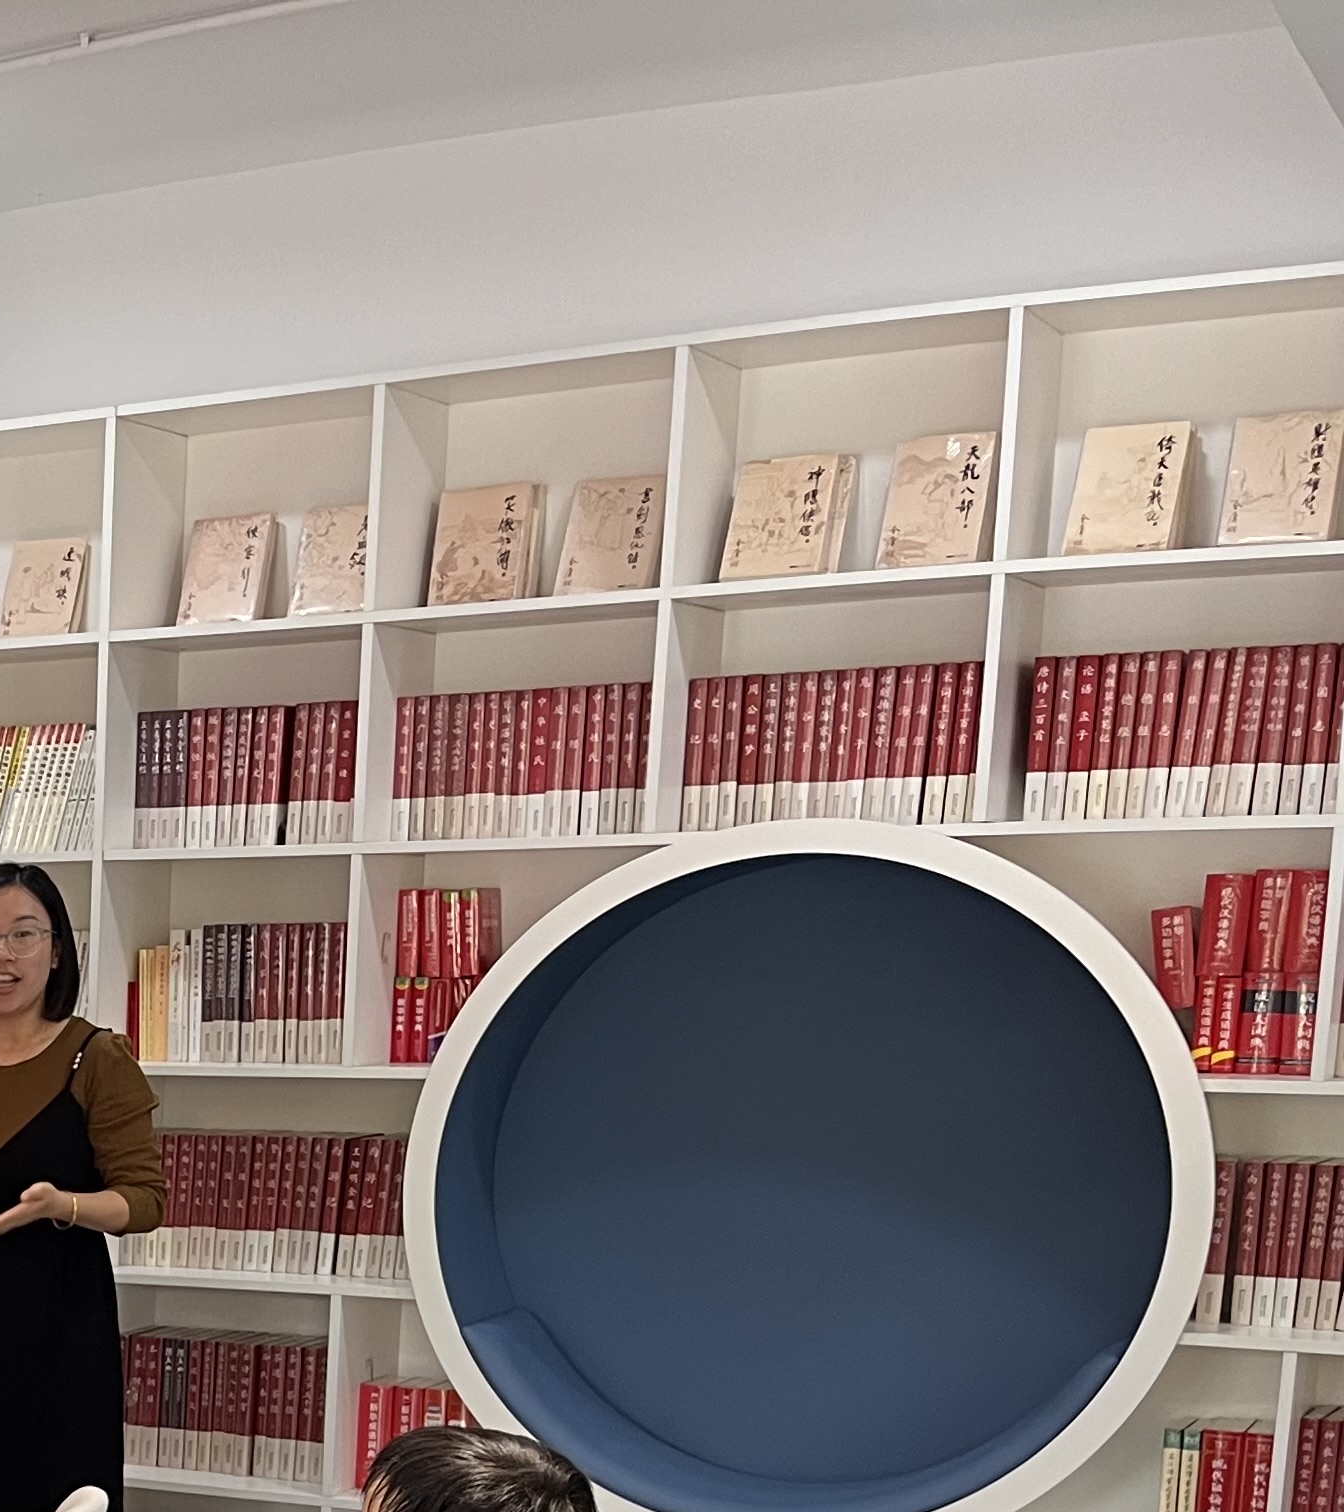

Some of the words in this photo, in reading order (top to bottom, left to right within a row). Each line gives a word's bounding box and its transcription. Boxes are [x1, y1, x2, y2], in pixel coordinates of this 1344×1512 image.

[1080, 665, 1095, 694] 论语
[1033, 665, 1050, 742] 唐诗三百首
[1077, 710, 1091, 742] 孟子
